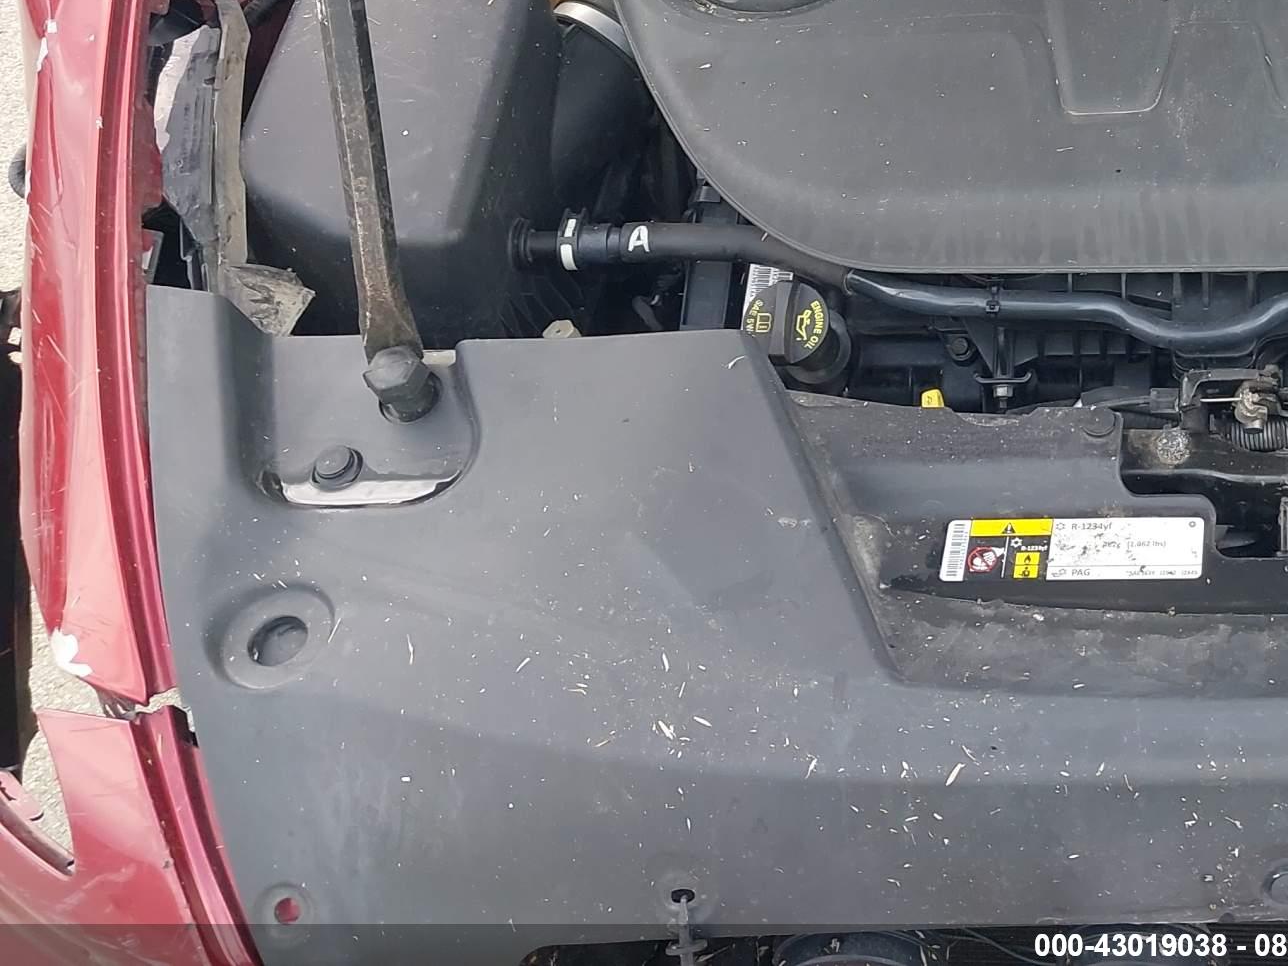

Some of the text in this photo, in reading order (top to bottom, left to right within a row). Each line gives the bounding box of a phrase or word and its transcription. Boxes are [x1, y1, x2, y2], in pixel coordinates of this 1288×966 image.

[628, 225, 650, 252] A
[748, 299, 764, 317] SAE
[804, 300, 824, 350] ENGINE OIL
[1071, 521, 1112, 533] R-1234yf
[1071, 568, 1091, 577] PAG
